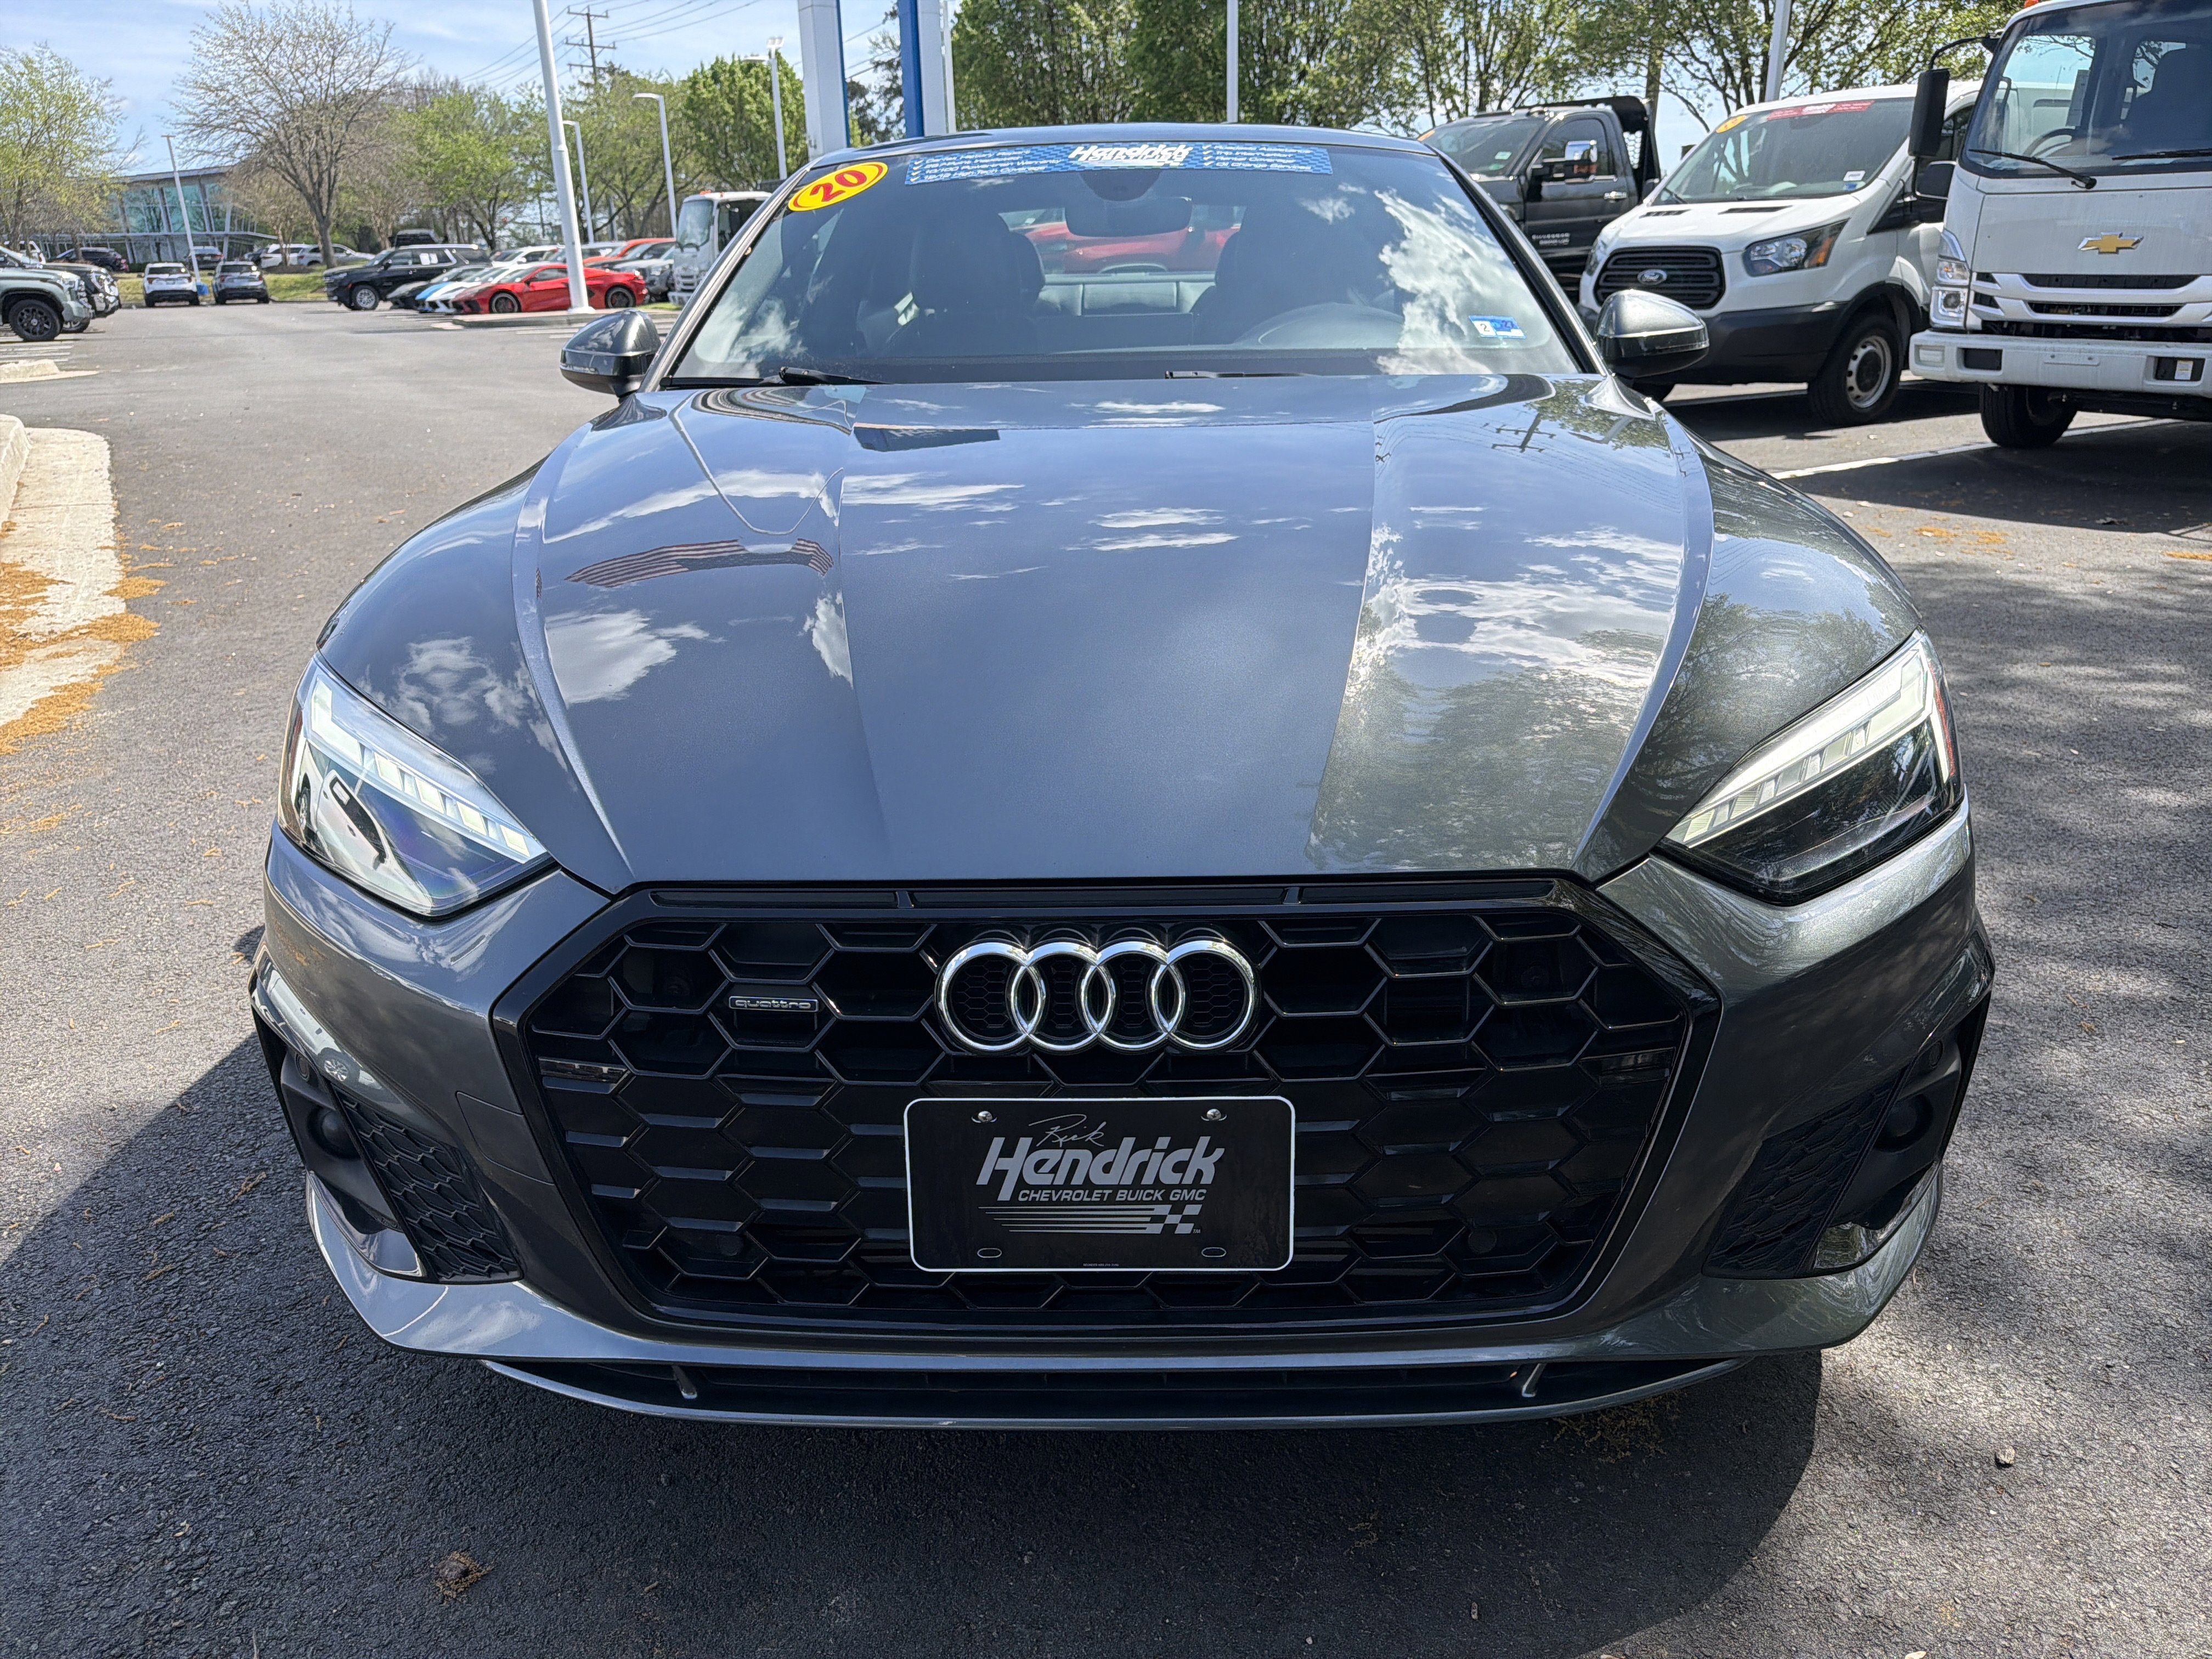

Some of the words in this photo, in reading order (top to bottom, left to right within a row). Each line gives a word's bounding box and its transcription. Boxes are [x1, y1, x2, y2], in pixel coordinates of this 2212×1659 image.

[1068, 144, 1194, 161] Hendrick
[810, 170, 867, 202] 20
[735, 999, 811, 1009] quattro
[976, 1136, 1225, 1201] Hendrick
[1018, 1189, 1113, 1201] CHEVROLET
[1115, 1189, 1163, 1201] BUICK
[1169, 1189, 1207, 1201] GMC
